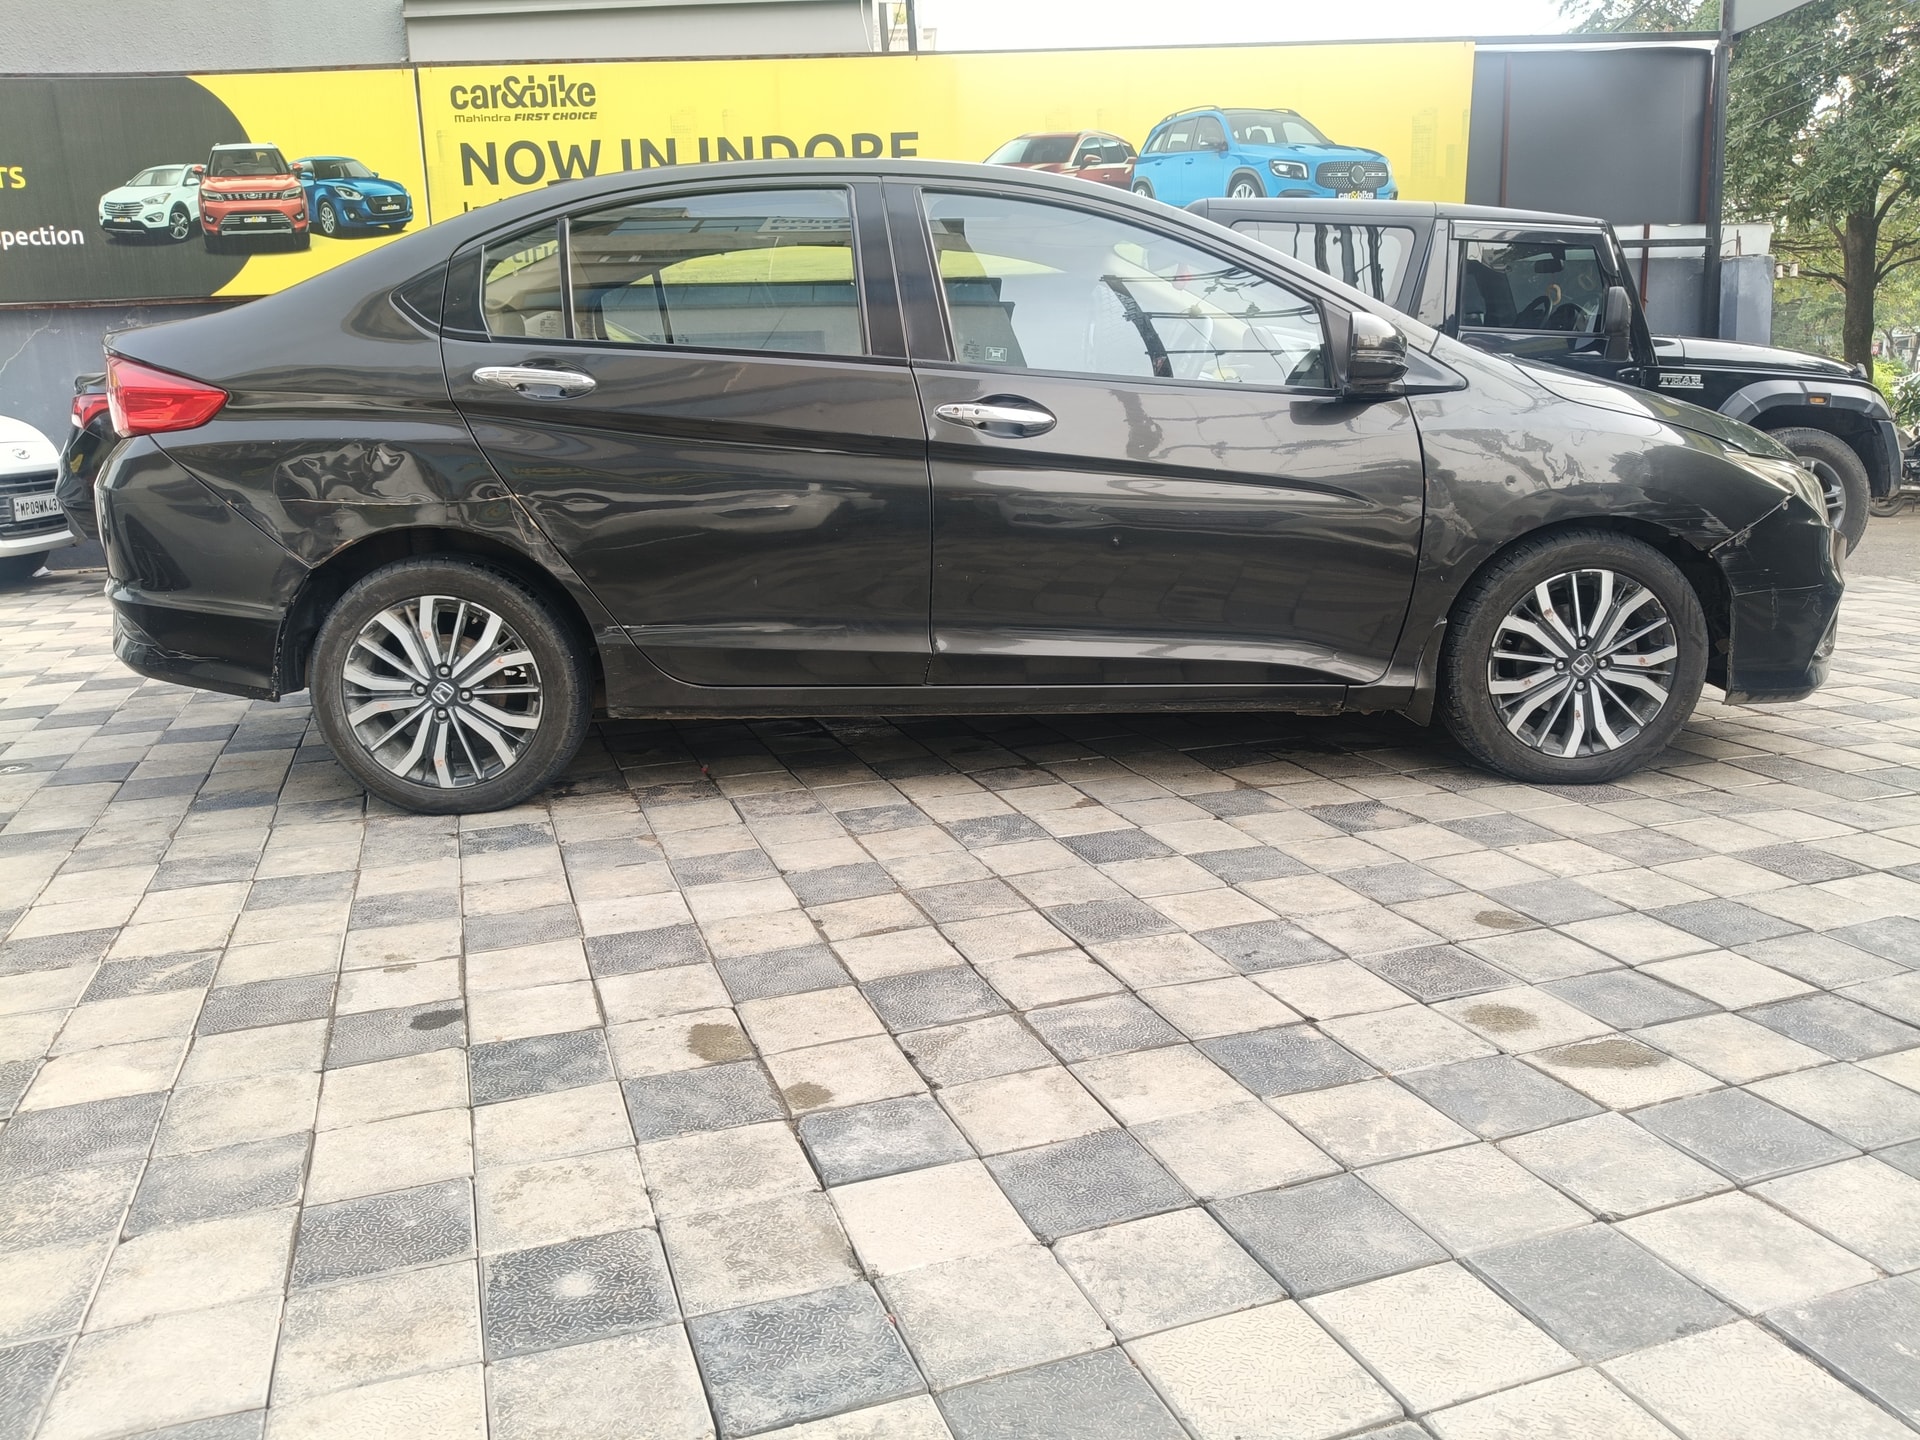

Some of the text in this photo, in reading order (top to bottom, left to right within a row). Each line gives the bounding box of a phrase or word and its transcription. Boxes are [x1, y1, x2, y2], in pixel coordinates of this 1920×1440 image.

[450, 74, 597, 110] car&bike
[454, 111, 598, 123] Mahindra FIRST CHOICE
[460, 138, 601, 186] NOW
[621, 137, 677, 171] IN
[0, 225, 84, 250] pection
